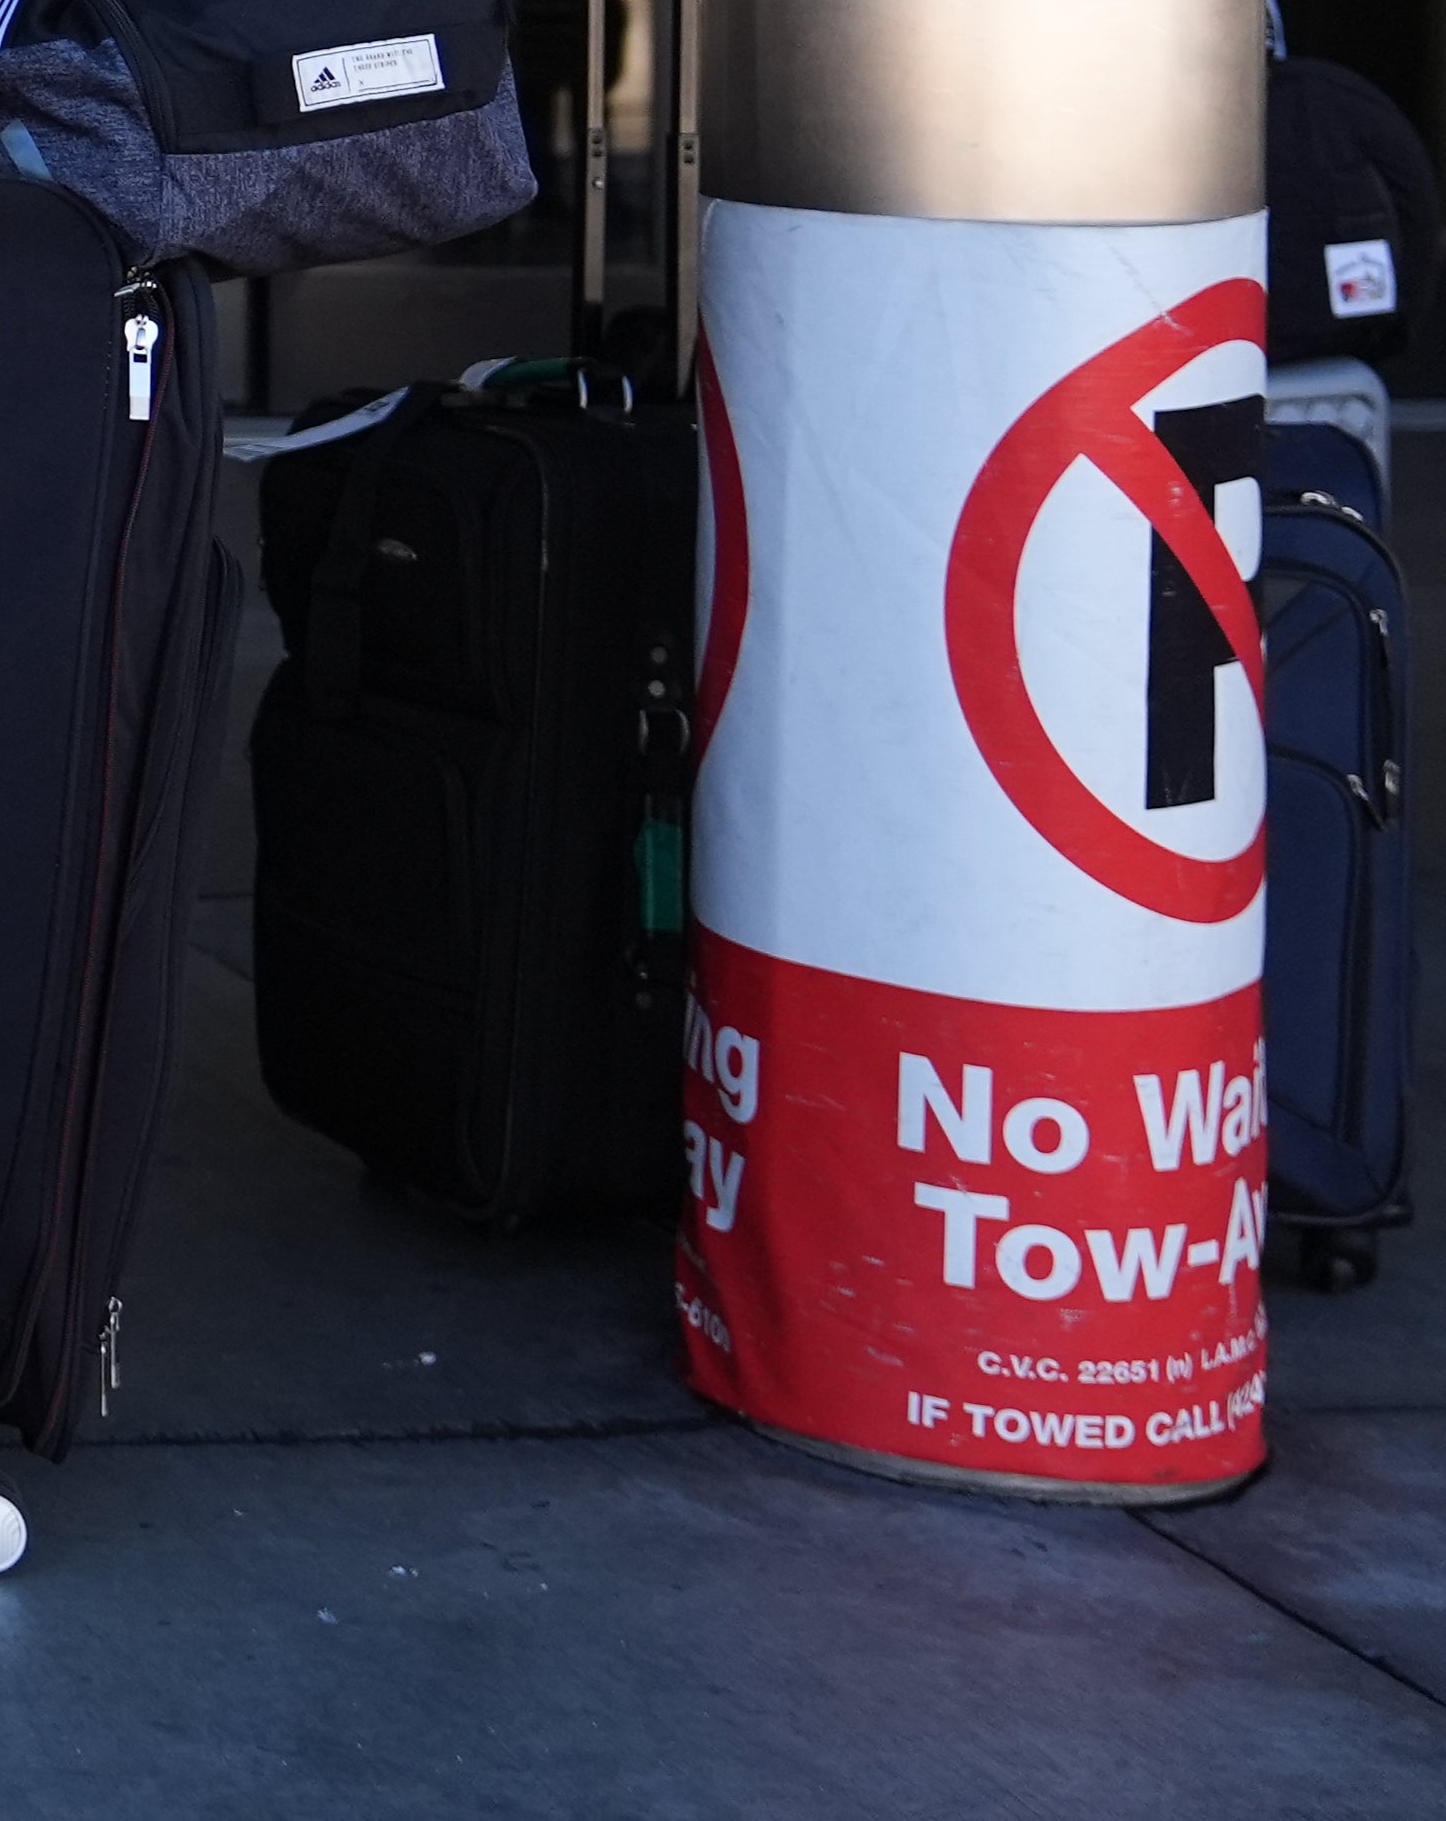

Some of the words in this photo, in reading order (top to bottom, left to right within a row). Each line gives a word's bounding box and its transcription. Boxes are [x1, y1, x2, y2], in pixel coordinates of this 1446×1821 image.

[310, 80, 342, 92] adidas
[895, 1050, 1090, 1175] No
[976, 1349, 1068, 1384] C.V.C.
[1077, 1357, 1159, 1386] 22651
[906, 1389, 949, 1429] IF
[963, 1404, 1135, 1449] TOWED
[1145, 1400, 1224, 1446] CALL
